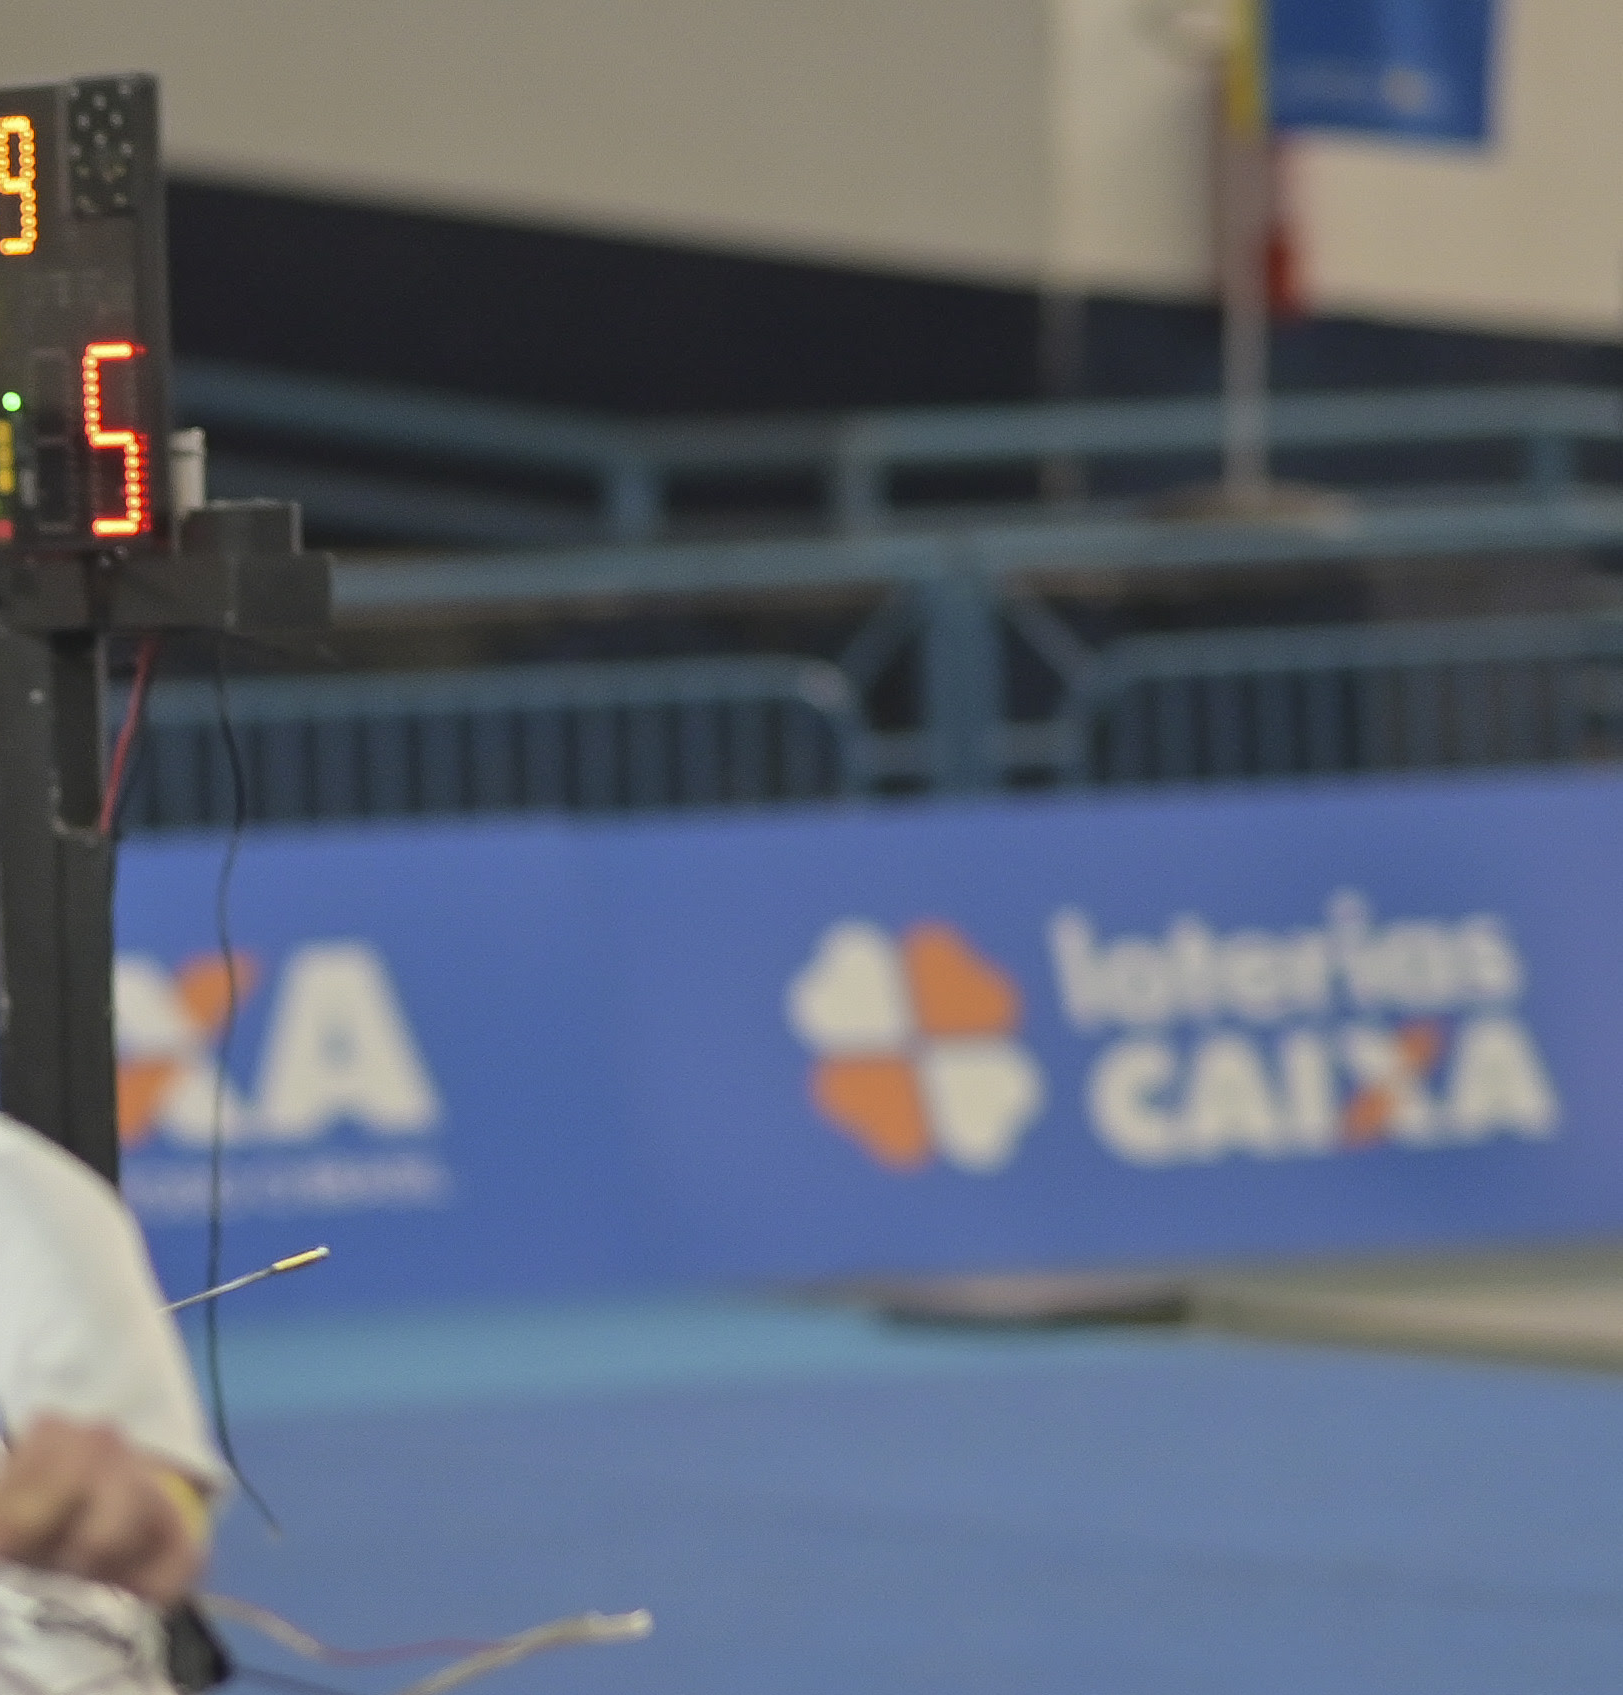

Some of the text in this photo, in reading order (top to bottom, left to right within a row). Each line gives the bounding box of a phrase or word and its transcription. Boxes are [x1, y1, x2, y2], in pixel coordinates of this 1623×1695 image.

[82, 342, 142, 536] 5
[1047, 888, 1521, 1034] loterias
[1088, 1014, 1556, 1165] CAIXA
